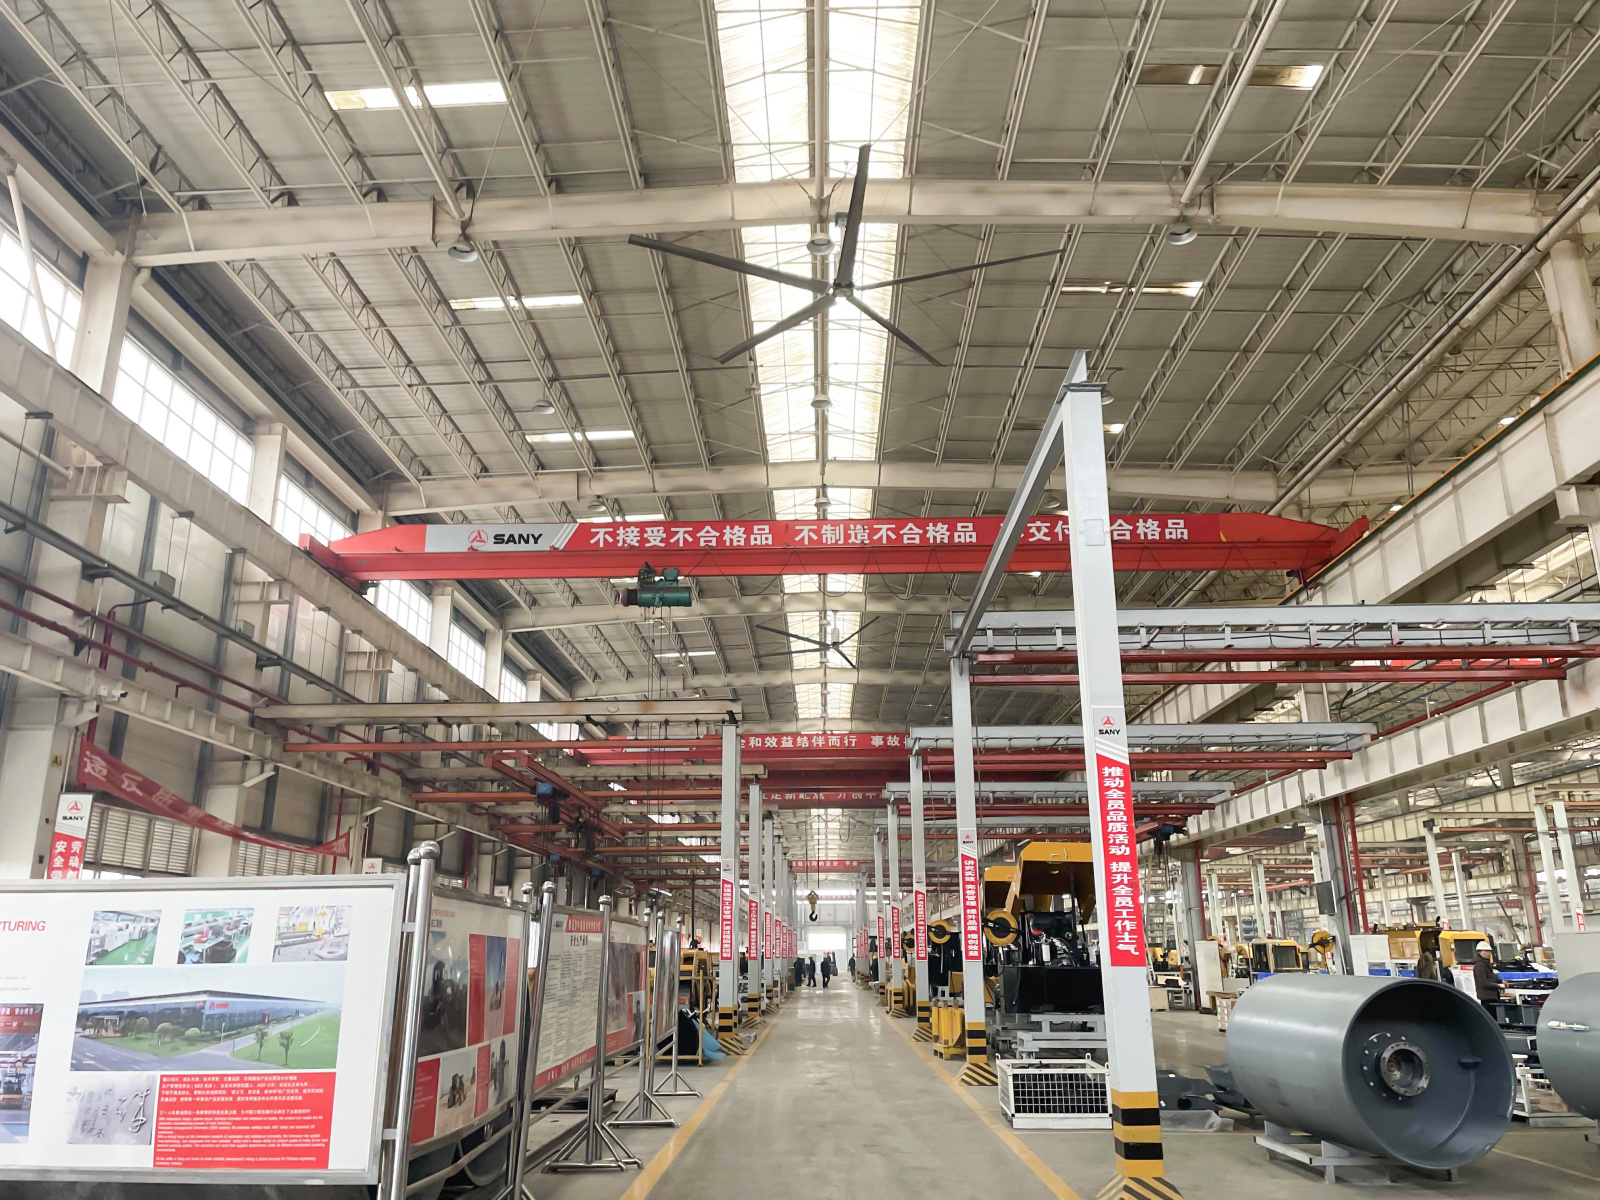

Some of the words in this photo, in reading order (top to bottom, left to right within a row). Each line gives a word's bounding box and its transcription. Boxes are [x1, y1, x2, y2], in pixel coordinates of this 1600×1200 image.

[492, 533, 543, 545] SANY
[590, 525, 774, 547] 不接受不合格品
[794, 522, 977, 545] 不制造不合格品
[871, 735, 906, 747] 事故
[1102, 766, 1130, 856] 推动全员品质活动
[1110, 861, 1139, 955] 提升全员工作士气
[0, 920, 46, 932] TURING
